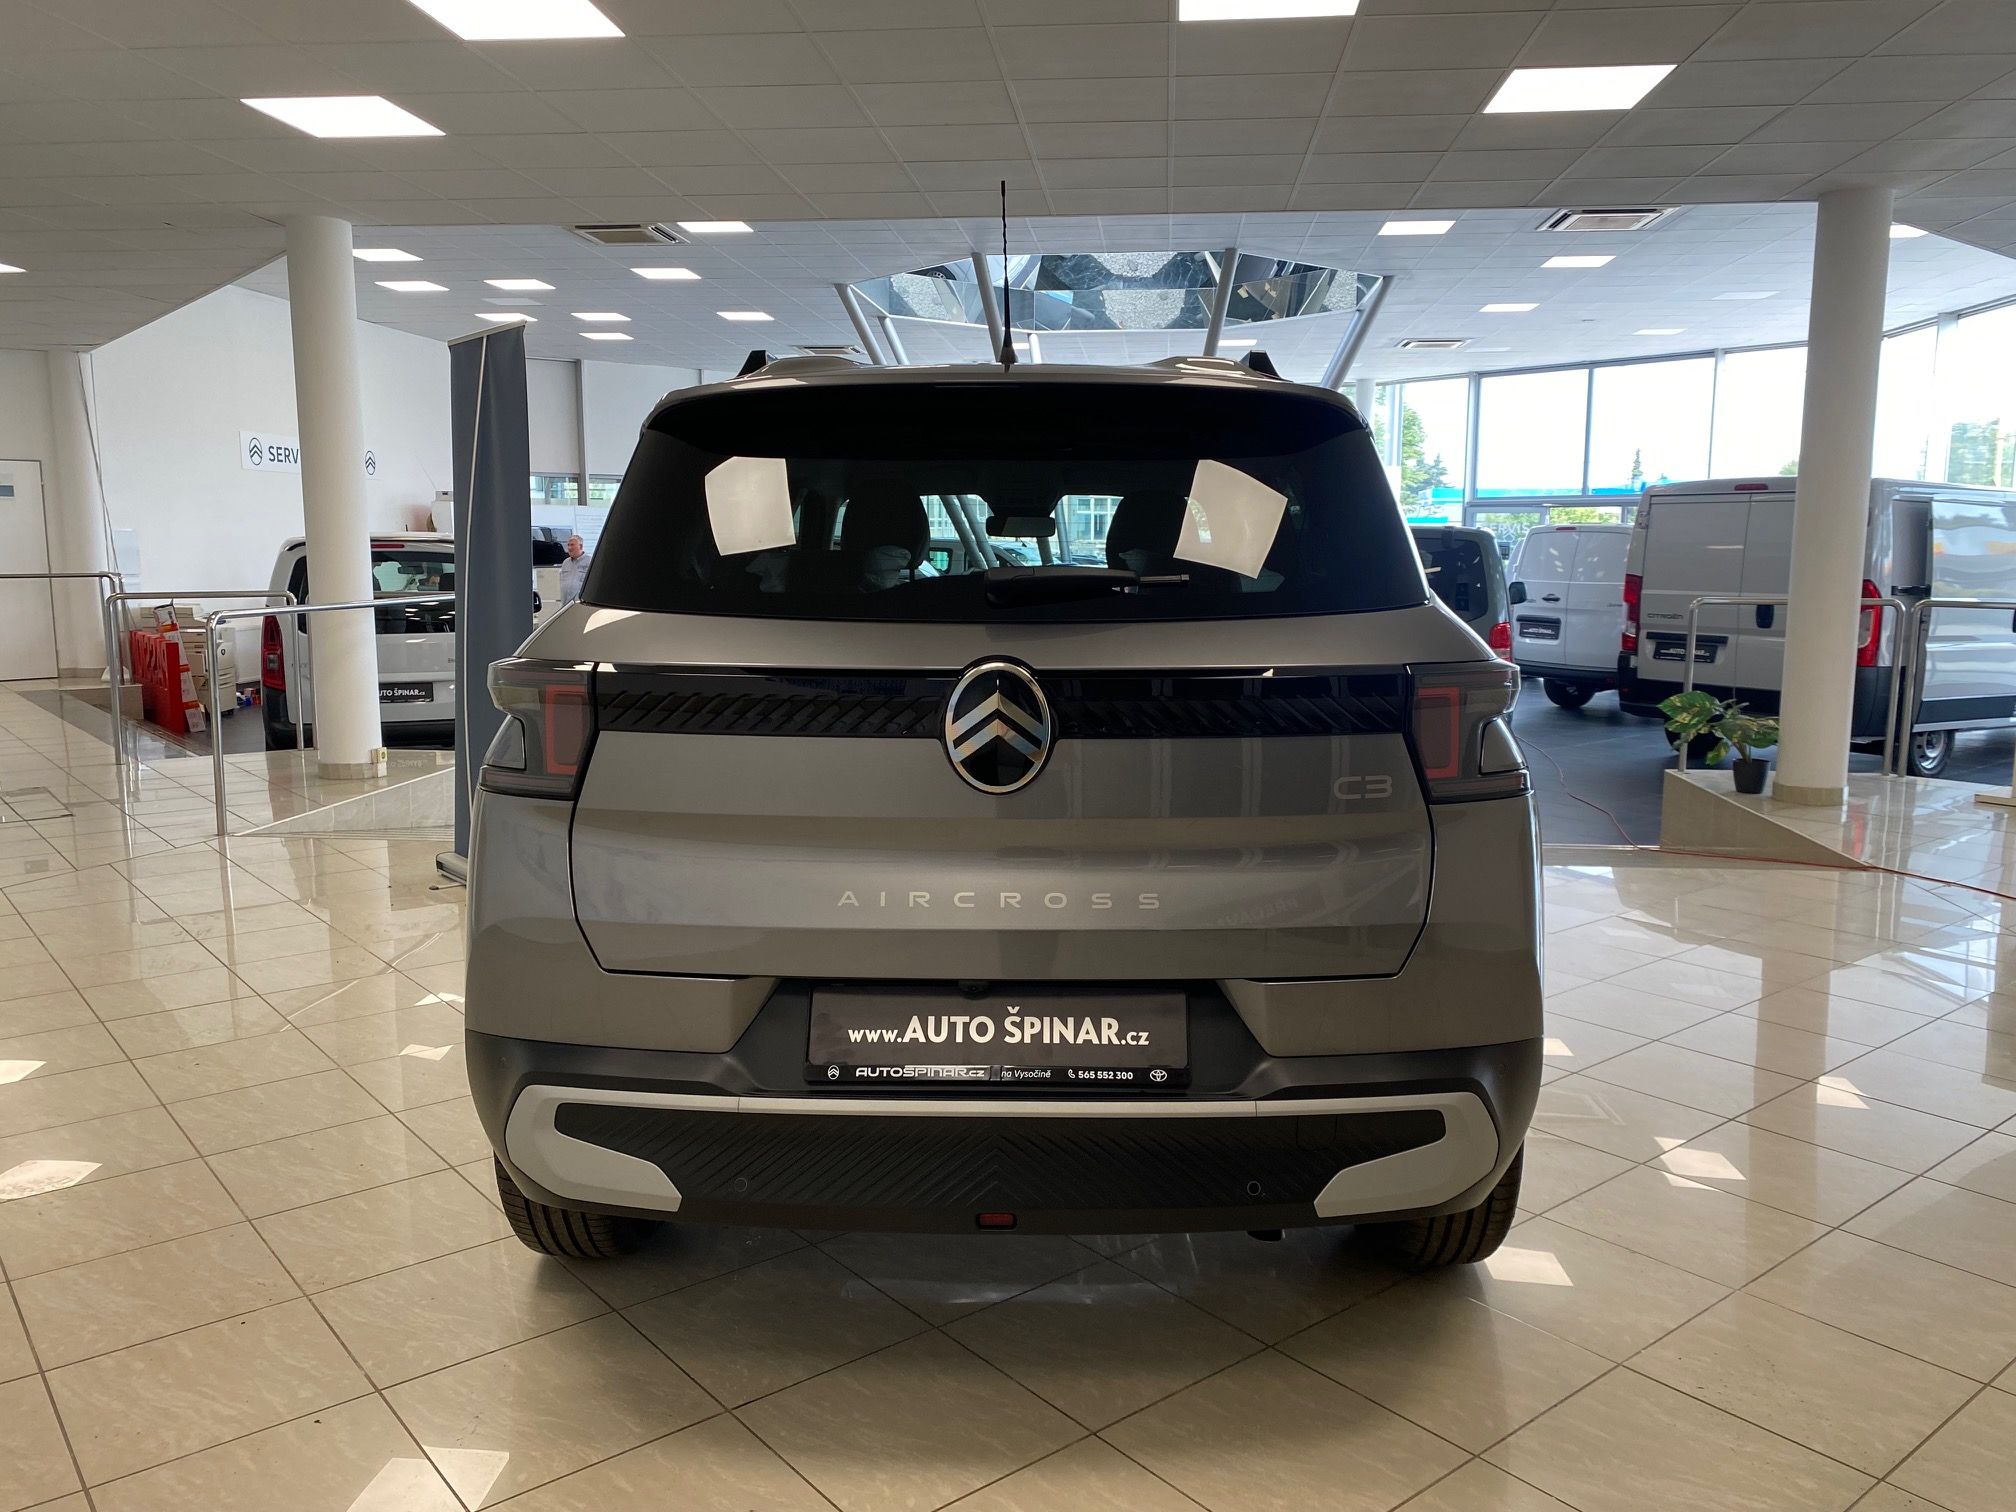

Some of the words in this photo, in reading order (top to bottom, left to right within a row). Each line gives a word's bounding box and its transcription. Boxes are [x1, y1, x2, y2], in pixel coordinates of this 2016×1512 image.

[1333, 774, 1393, 800] C3
[837, 891, 1160, 910] AIRCROSS
[848, 1015, 995, 1043] www.AUTO
[1003, 1006, 1150, 1046] ŠPINAR.cz
[1014, 1069, 1052, 1079] Vysočině
[1078, 1071, 1096, 1079] 565
[1097, 1071, 1114, 1079] 552
[1116, 1071, 1133, 1080] 300
